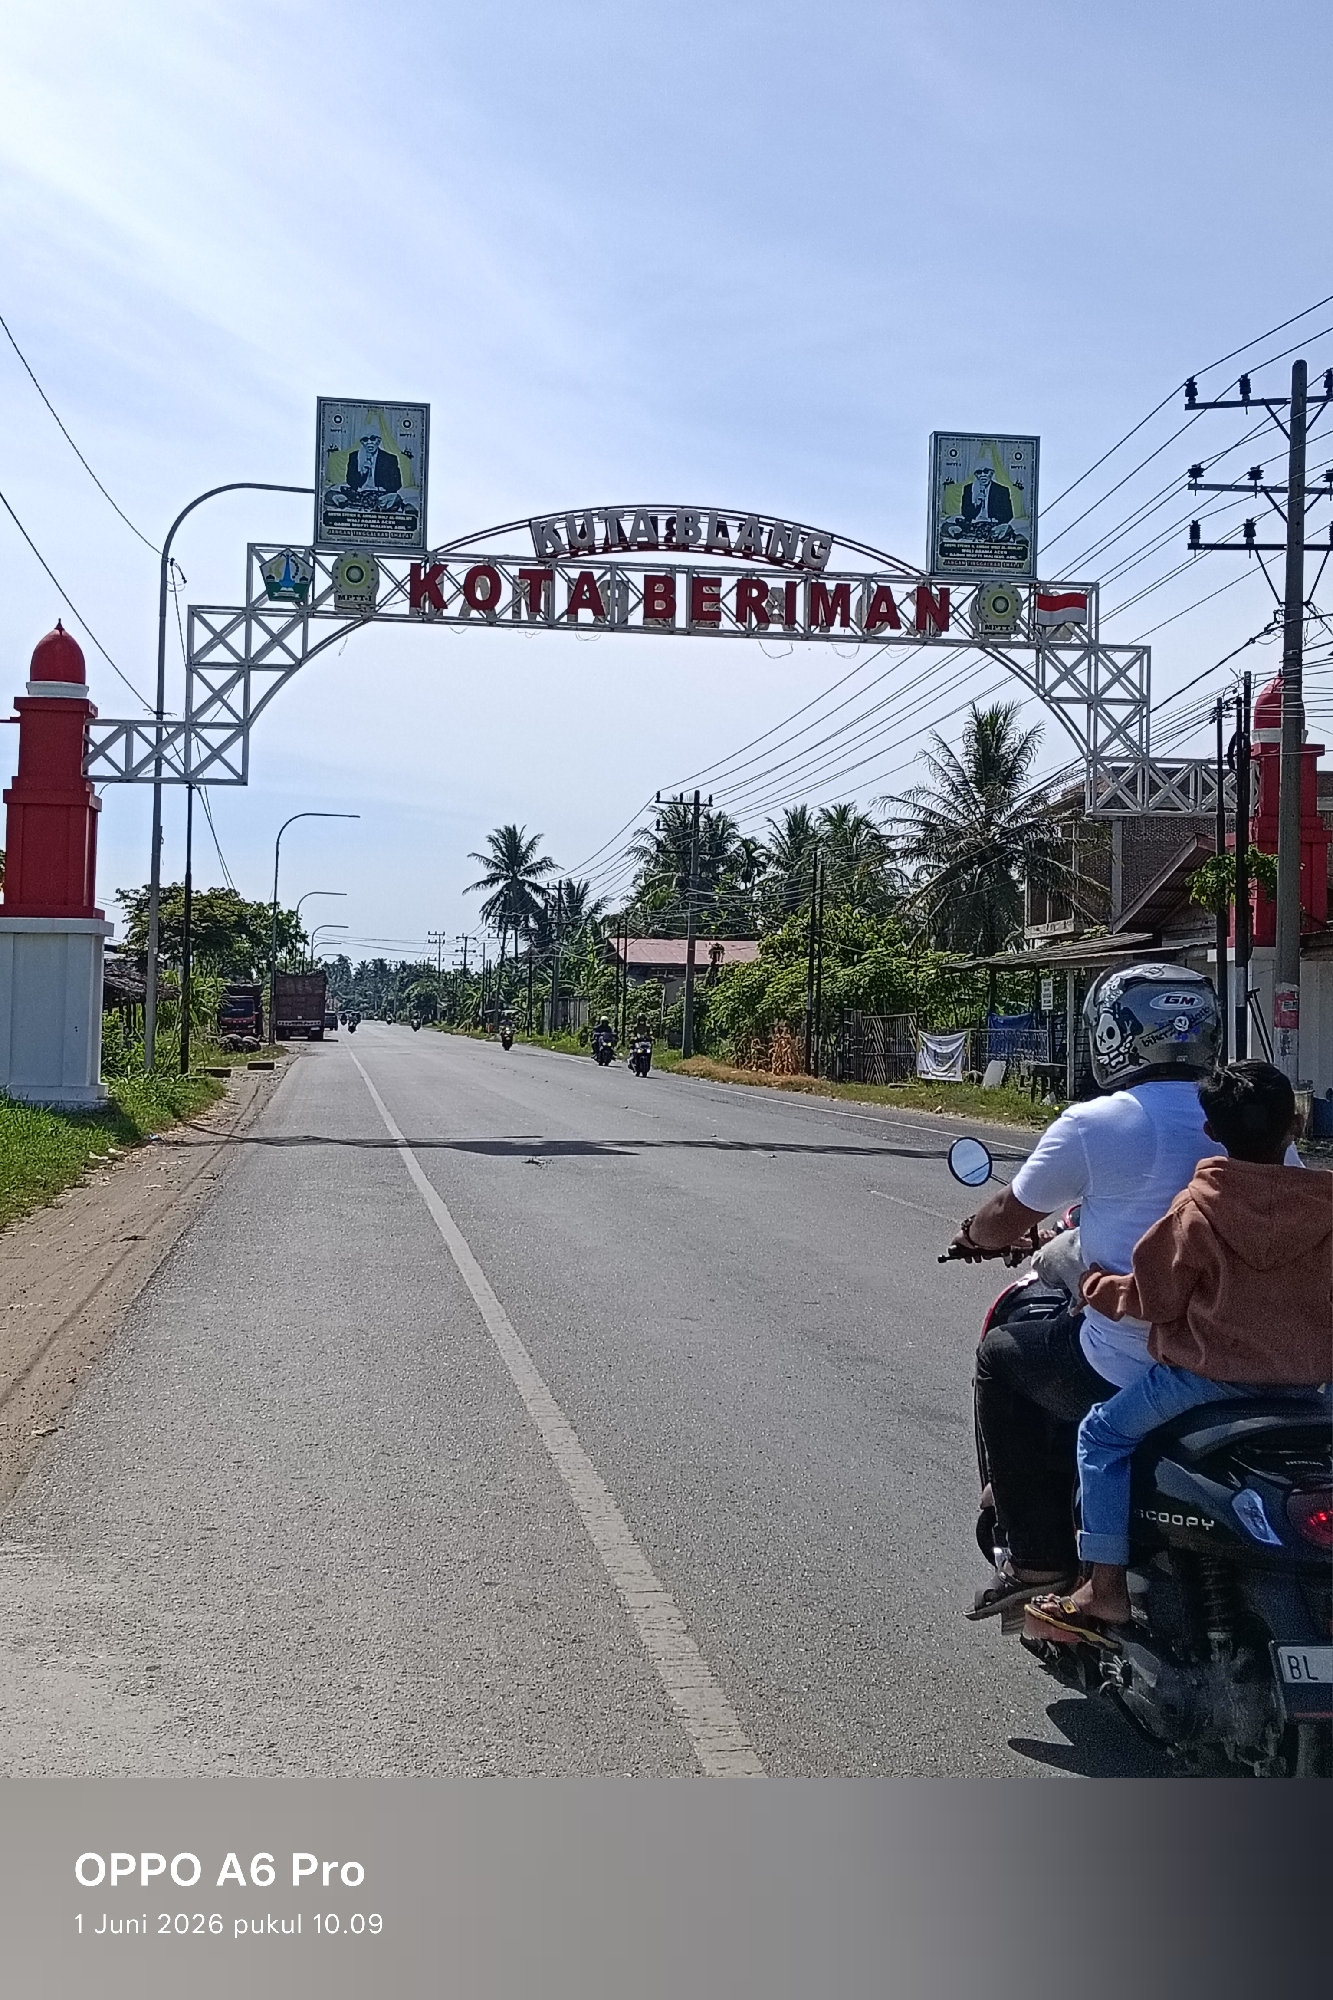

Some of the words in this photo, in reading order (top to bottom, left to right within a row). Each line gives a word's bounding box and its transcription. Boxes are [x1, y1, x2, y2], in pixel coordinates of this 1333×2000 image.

[531, 509, 658, 557] KUTA
[676, 509, 833, 568] BLANG
[410, 563, 606, 617] KOTA
[643, 574, 951, 632] BERIMAN
[1164, 996, 1195, 1006] GM
[1287, 1655, 1319, 1680] BL
